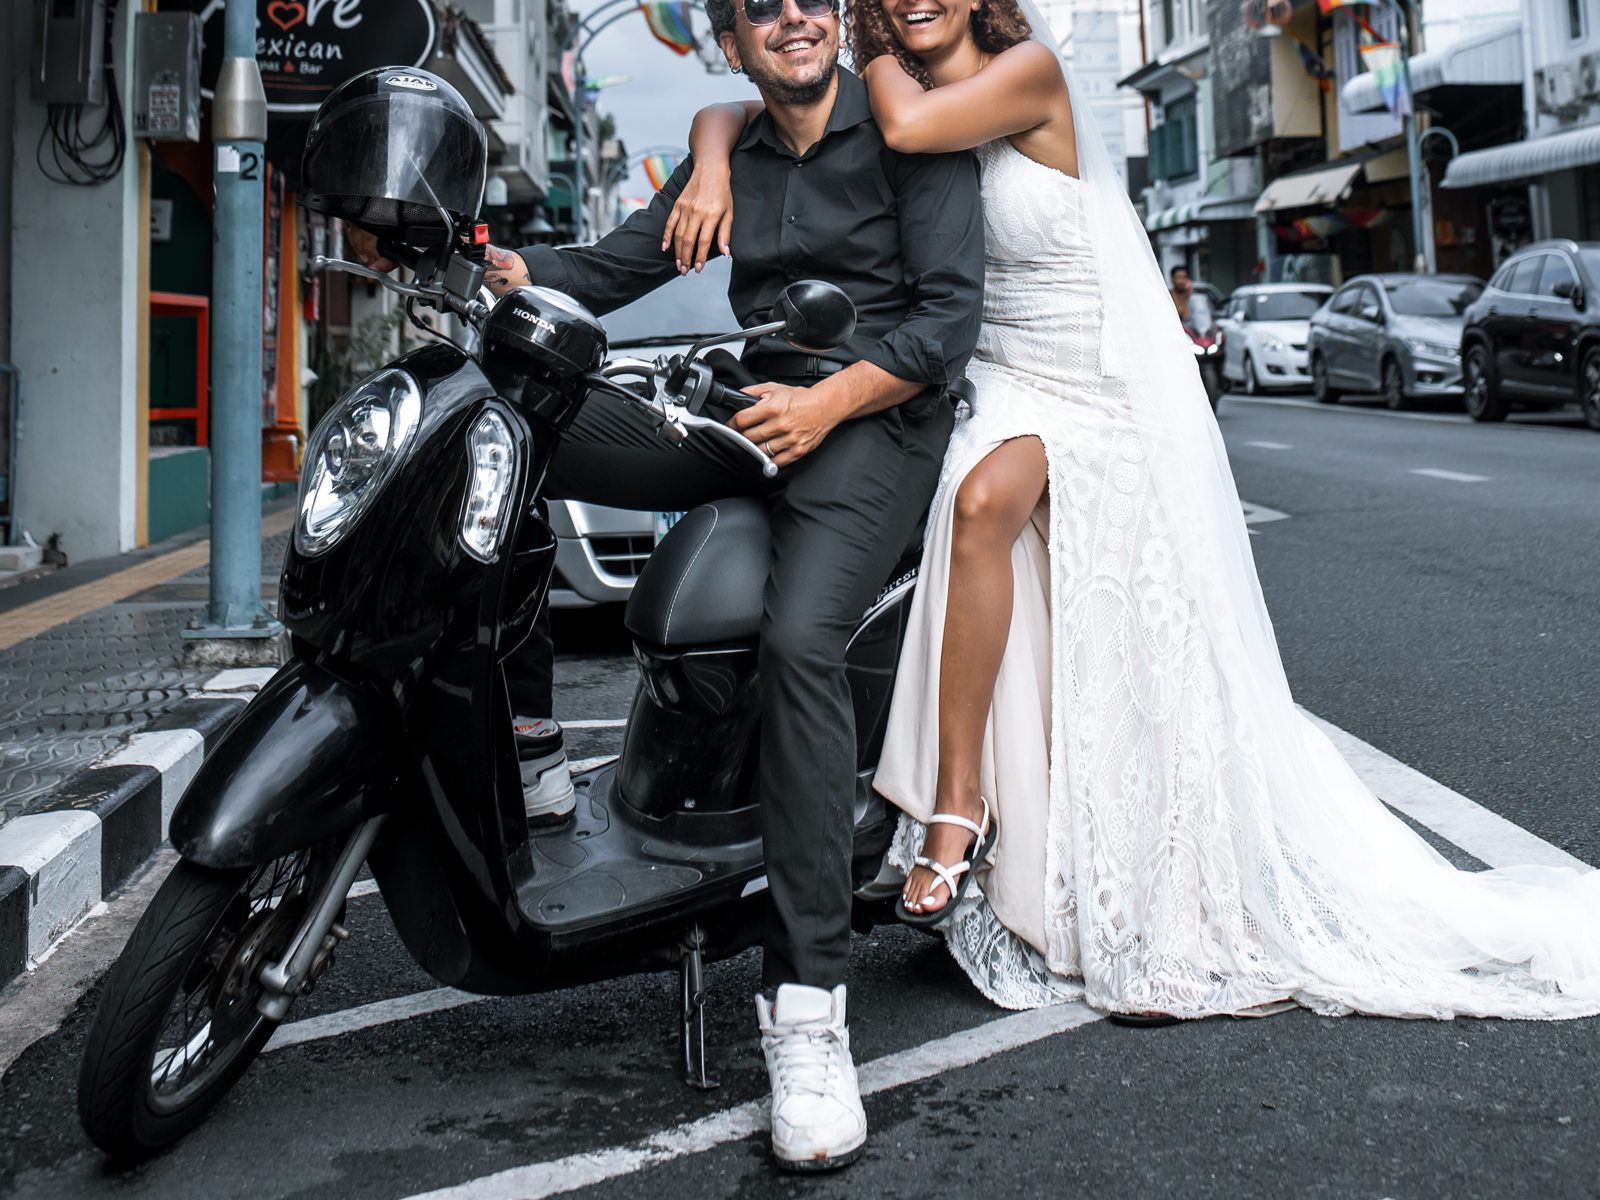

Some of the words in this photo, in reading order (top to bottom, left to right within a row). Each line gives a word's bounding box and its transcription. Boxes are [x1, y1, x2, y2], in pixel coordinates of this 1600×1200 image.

[255, 32, 344, 60] exican
[259, 60, 280, 73] pas
[299, 60, 324, 75] Bar
[239, 152, 258, 180] 2
[512, 307, 556, 335] HONDA
